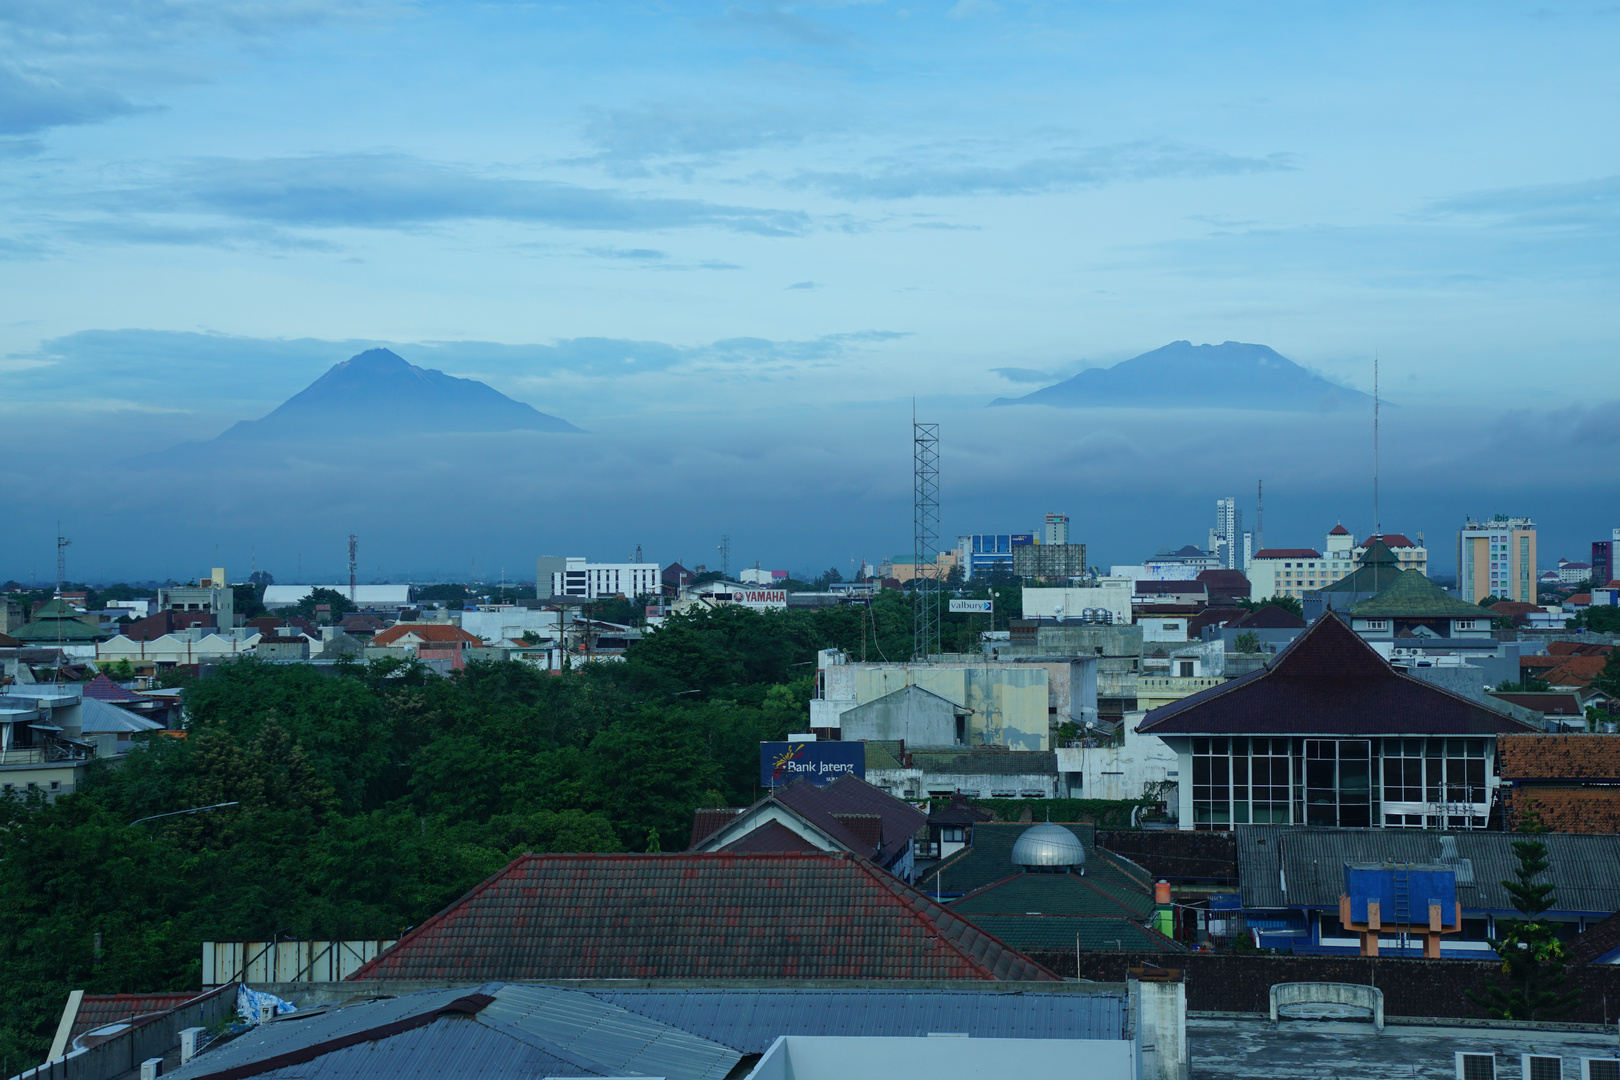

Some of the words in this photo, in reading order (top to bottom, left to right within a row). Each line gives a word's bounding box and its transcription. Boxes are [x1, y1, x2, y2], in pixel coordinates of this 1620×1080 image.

[1494, 514, 1509, 522] ibis
[745, 591, 786, 602] YAMAHA
[951, 601, 983, 610] valbury
[788, 761, 816, 772] Bank
[819, 761, 854, 774] Jateng
